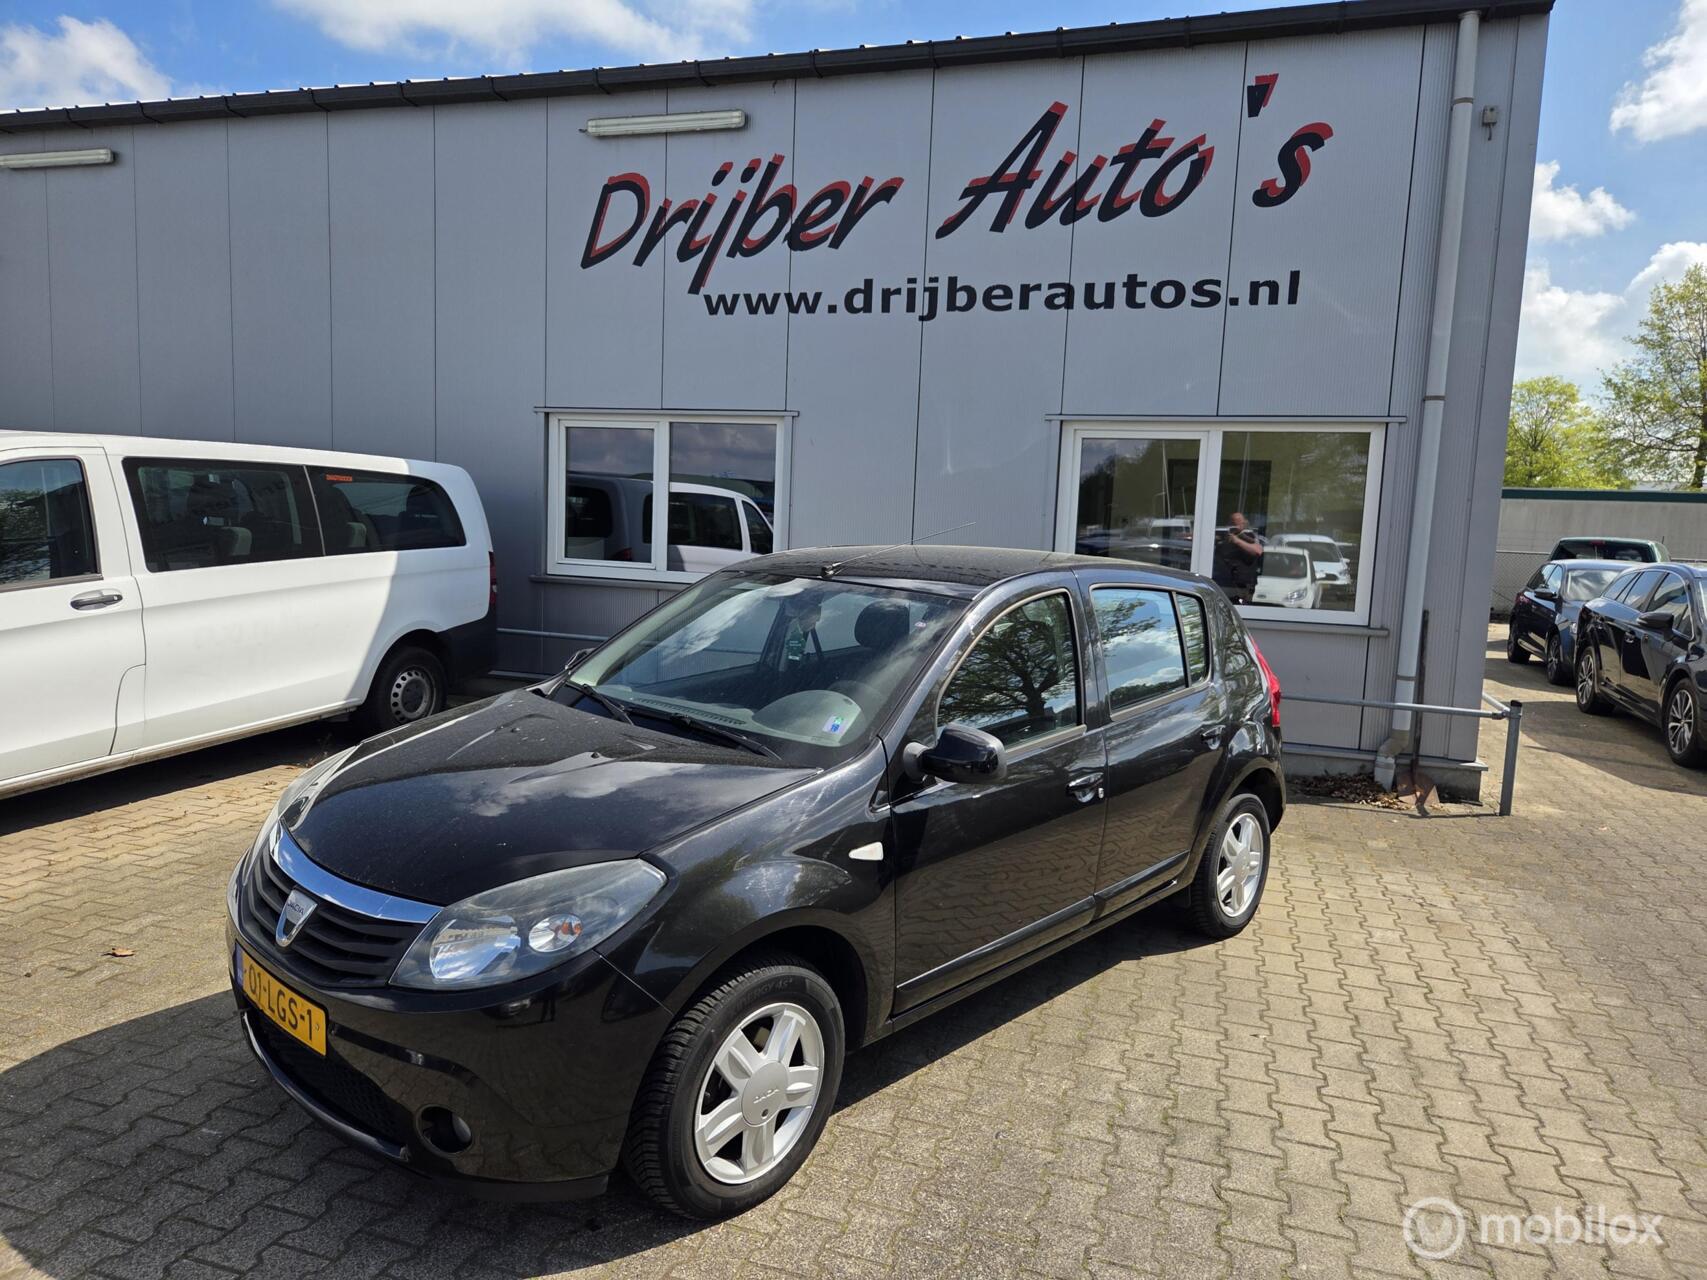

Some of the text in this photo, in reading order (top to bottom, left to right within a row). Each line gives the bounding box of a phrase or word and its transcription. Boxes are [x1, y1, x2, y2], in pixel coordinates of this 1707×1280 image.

[581, 74, 1333, 295] Drijber Auto's
[703, 270, 1300, 322] www.drijberautos.nl
[249, 964, 312, 1041] 01-LGS-1
